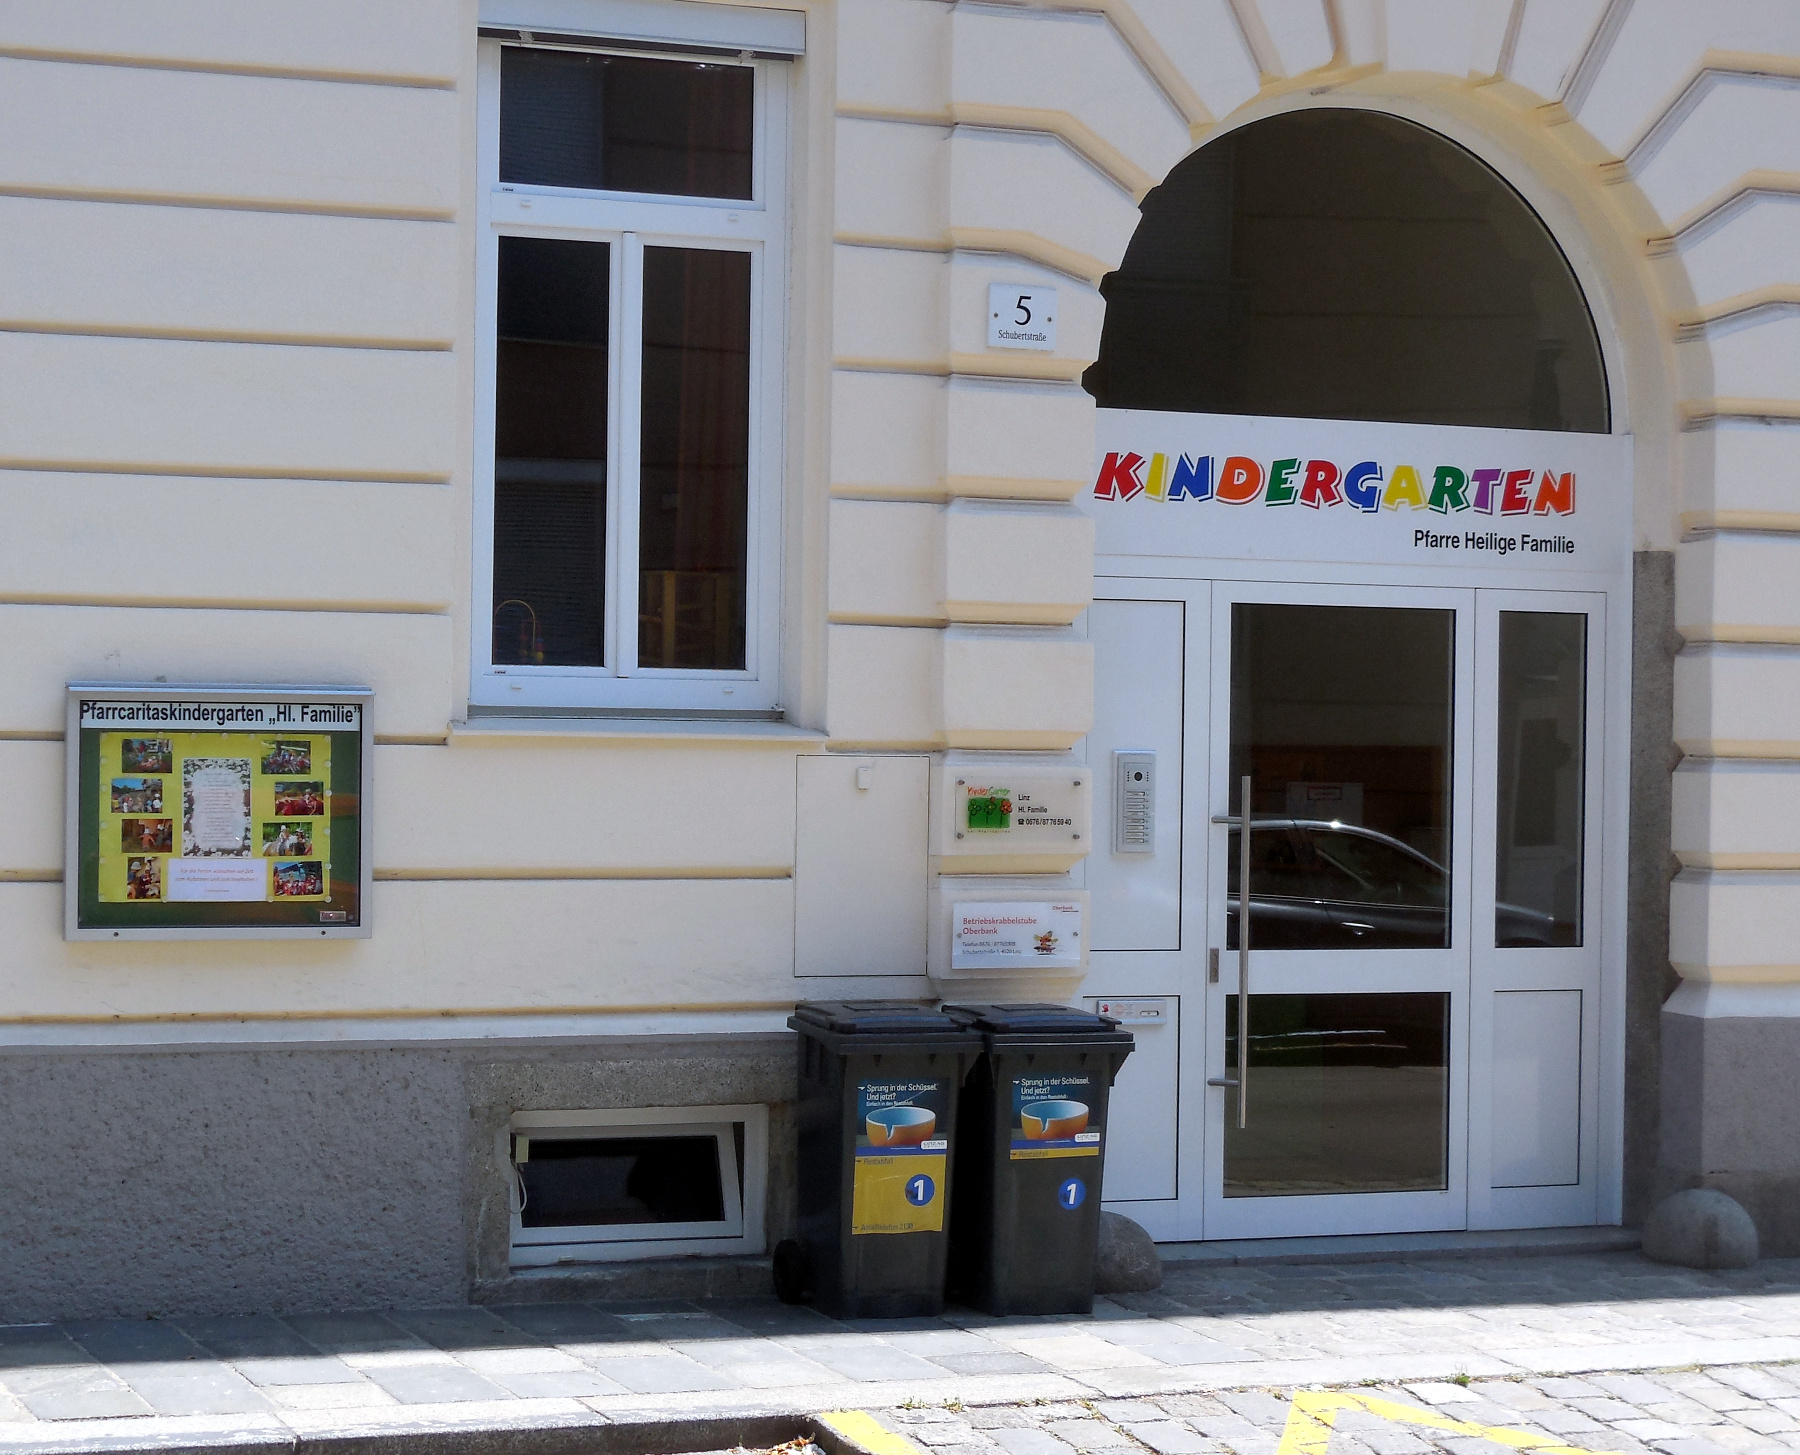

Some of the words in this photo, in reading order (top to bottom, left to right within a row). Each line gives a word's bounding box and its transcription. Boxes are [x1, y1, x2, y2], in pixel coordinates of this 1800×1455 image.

[1014, 295, 1032, 326] 5
[998, 329, 1047, 342] Schubertstraße
[1093, 451, 1577, 518] KINDERGARTEN
[1414, 529, 1460, 550] Pfarre
[1464, 532, 1517, 555] Heilige
[1521, 535, 1575, 554] Familie
[80, 702, 264, 726] Pfarrcaritaskindergarten
[962, 917, 1037, 925] Betriebskrabbelstube
[962, 927, 998, 935] Oberbank
[866, 1083, 889, 1093] Sprung
[890, 1083, 895, 1091] in
[896, 1083, 907, 1091] der
[1020, 1077, 1042, 1087] Sprung
[1043, 1077, 1049, 1085] in
[1050, 1077, 1061, 1085] der
[866, 1093, 879, 1101] Und
[880, 1092, 896, 1102] jetzt?
[1021, 1086, 1033, 1094] Und
[1034, 1086, 1050, 1096] jetzt?
[914, 1179, 925, 1201] 1
[1067, 1183, 1077, 1205] 1
